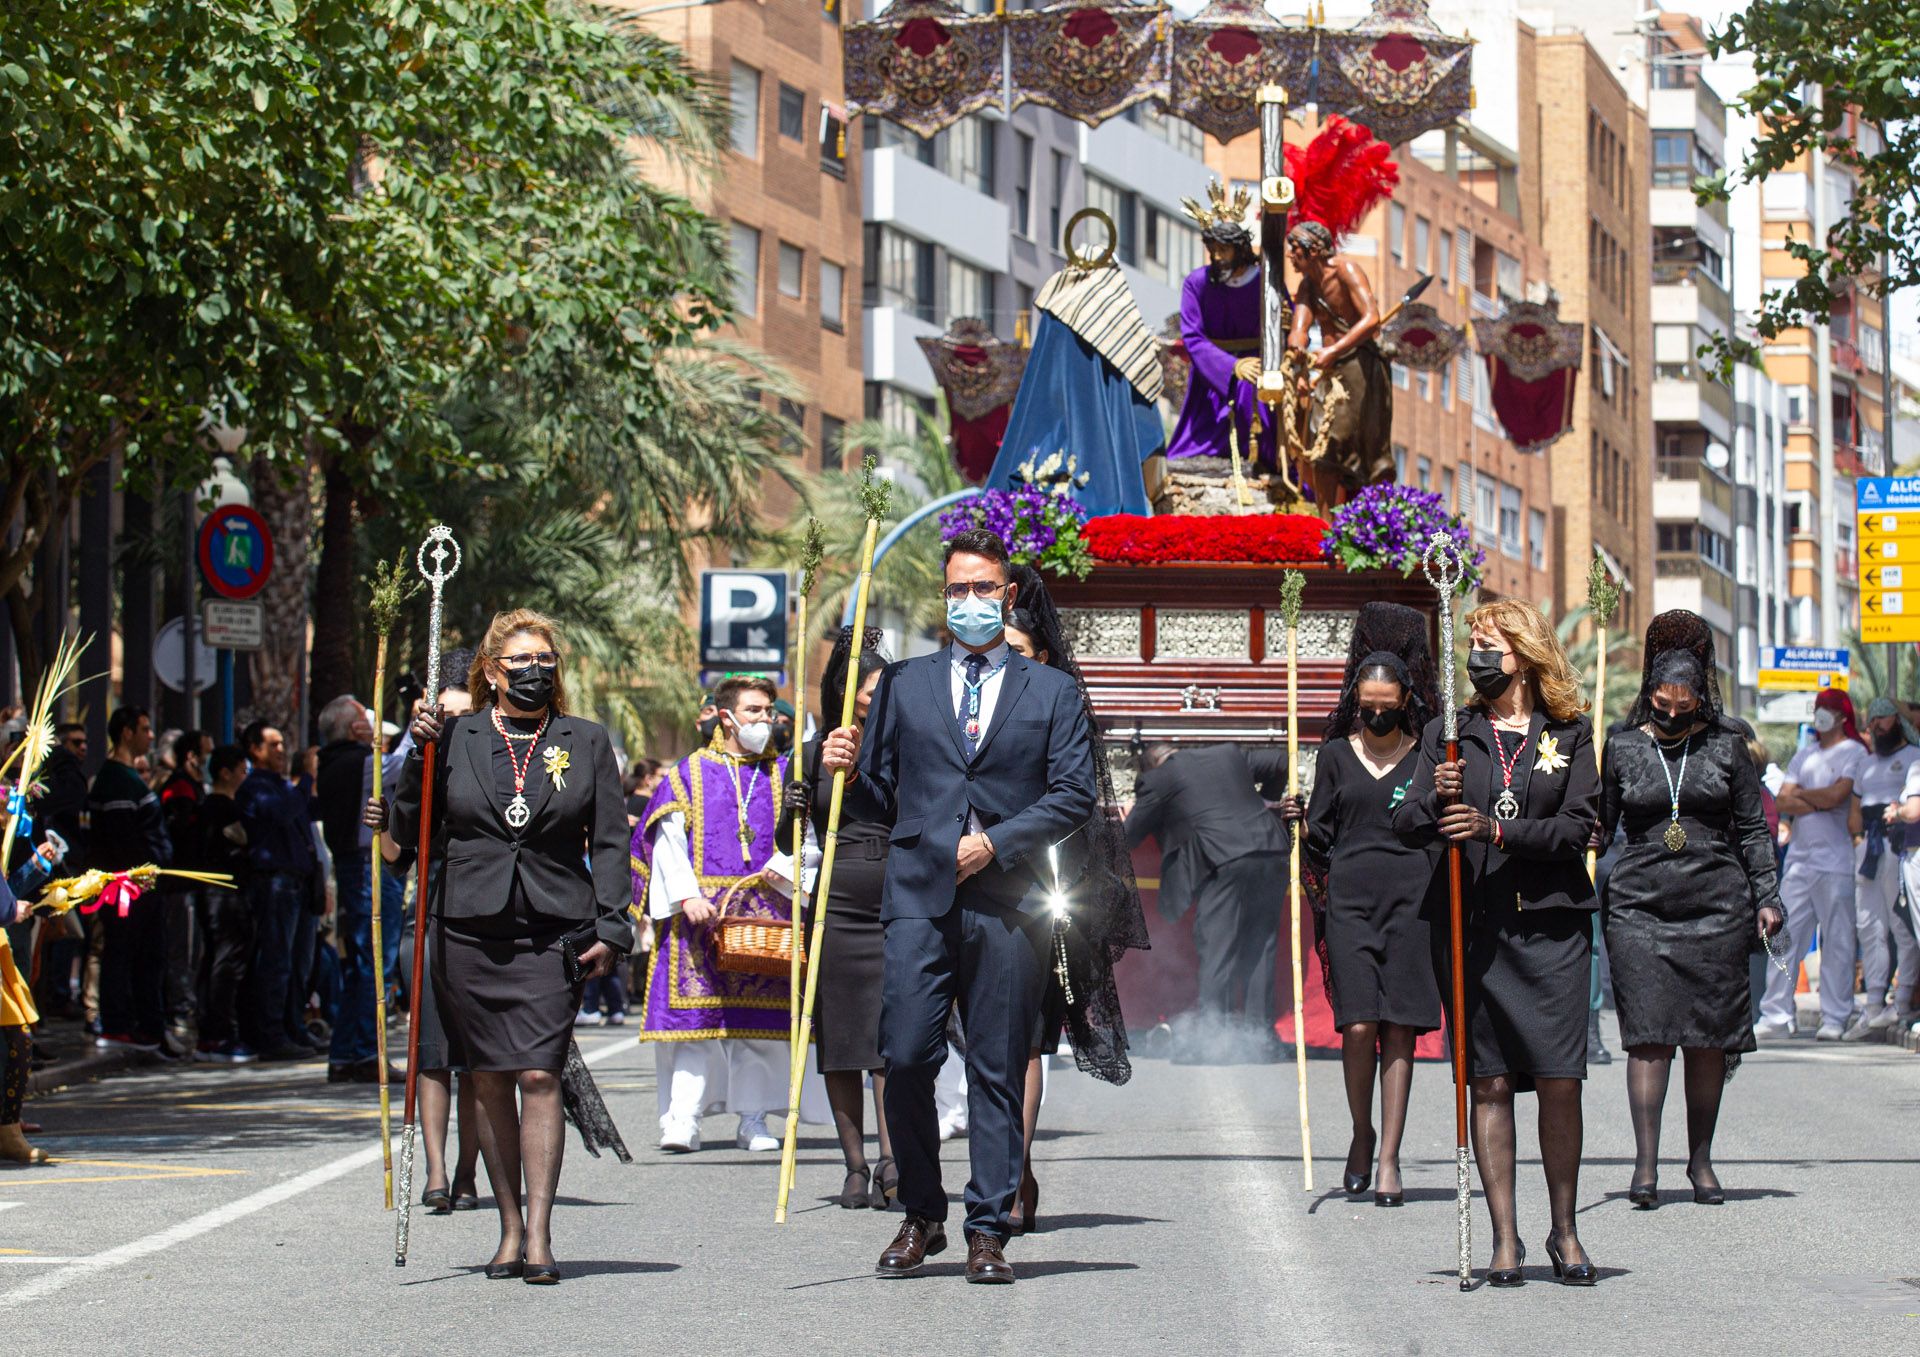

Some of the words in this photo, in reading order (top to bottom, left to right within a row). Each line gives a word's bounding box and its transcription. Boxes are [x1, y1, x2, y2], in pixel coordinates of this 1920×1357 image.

[1889, 479, 1920, 493] ALIC
[711, 574, 777, 648] P
[1784, 648, 1837, 660] ALICANTE
